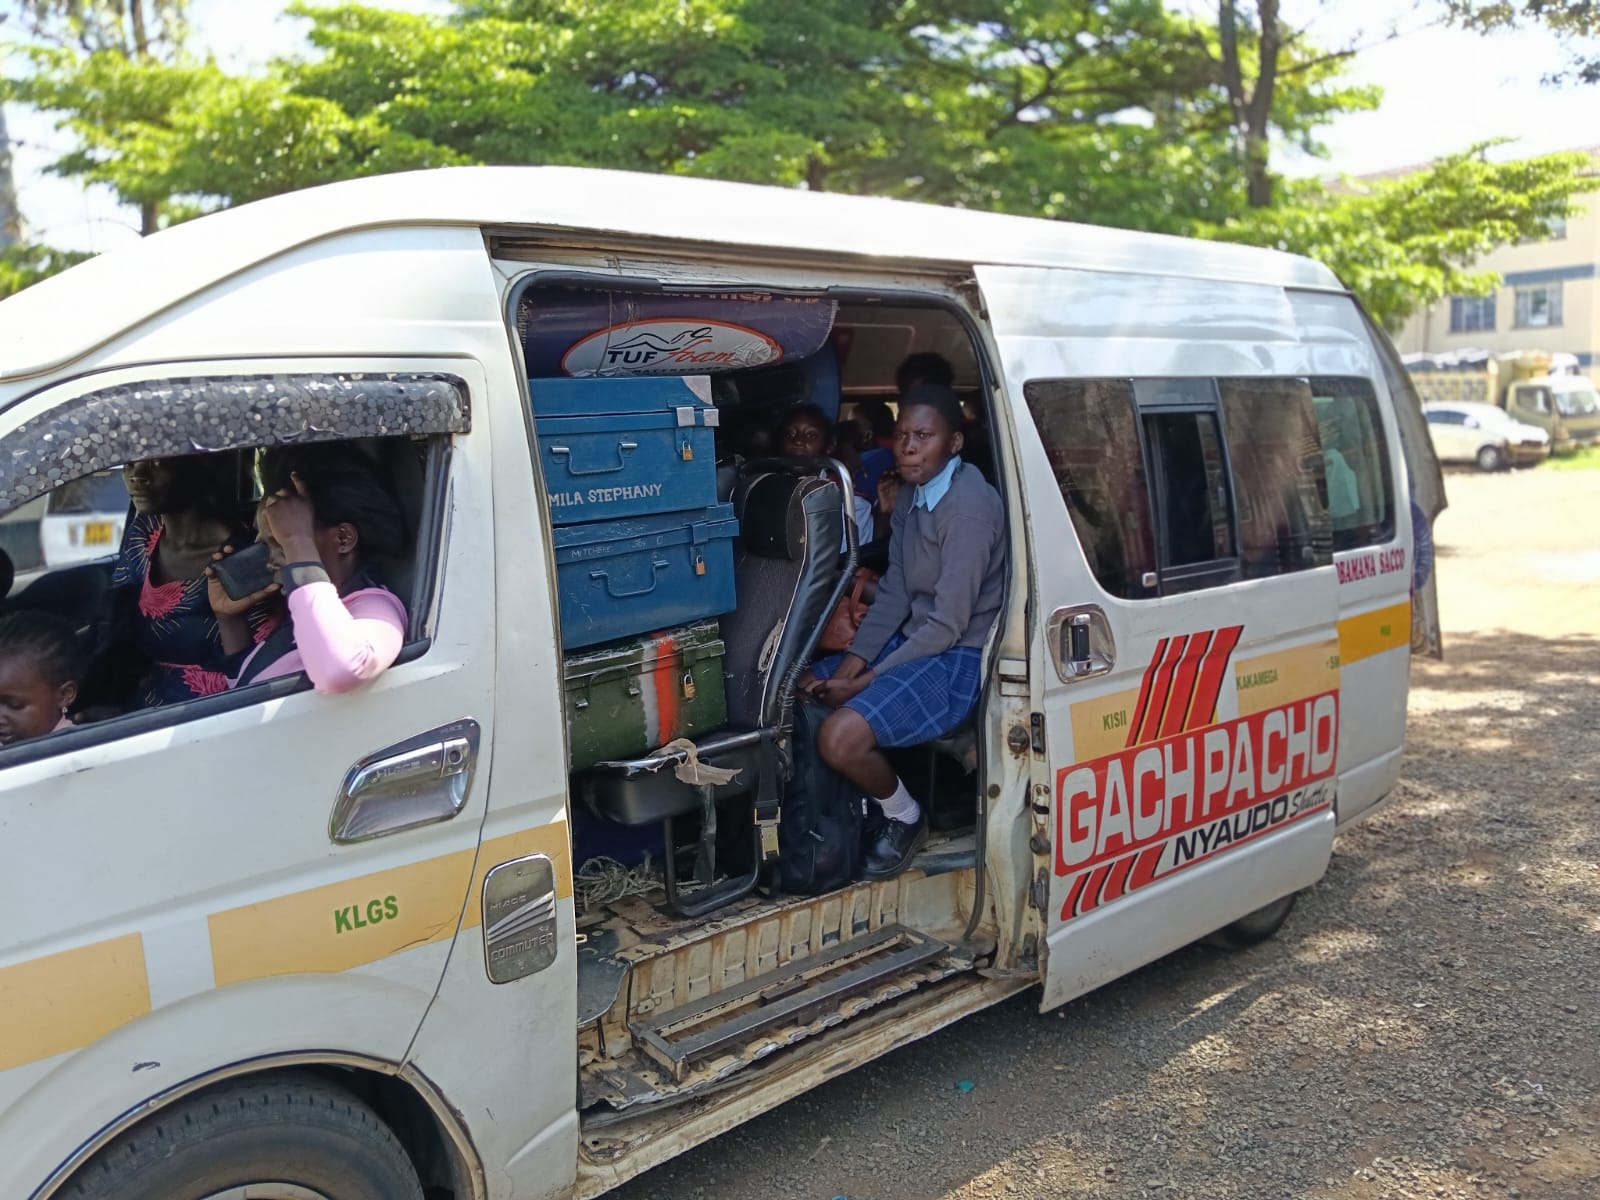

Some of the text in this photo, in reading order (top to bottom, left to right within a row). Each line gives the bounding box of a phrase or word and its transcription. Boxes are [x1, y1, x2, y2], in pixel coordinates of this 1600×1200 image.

[608, 338, 737, 364] TUF foam
[587, 483, 662, 503] STEPHANY
[1379, 548, 1404, 575] SACCO
[1236, 668, 1278, 691] KAKAMEGA
[1103, 710, 1127, 731] KISII
[1173, 795, 1290, 866] NYAUDO
[334, 895, 398, 934] KLGS
